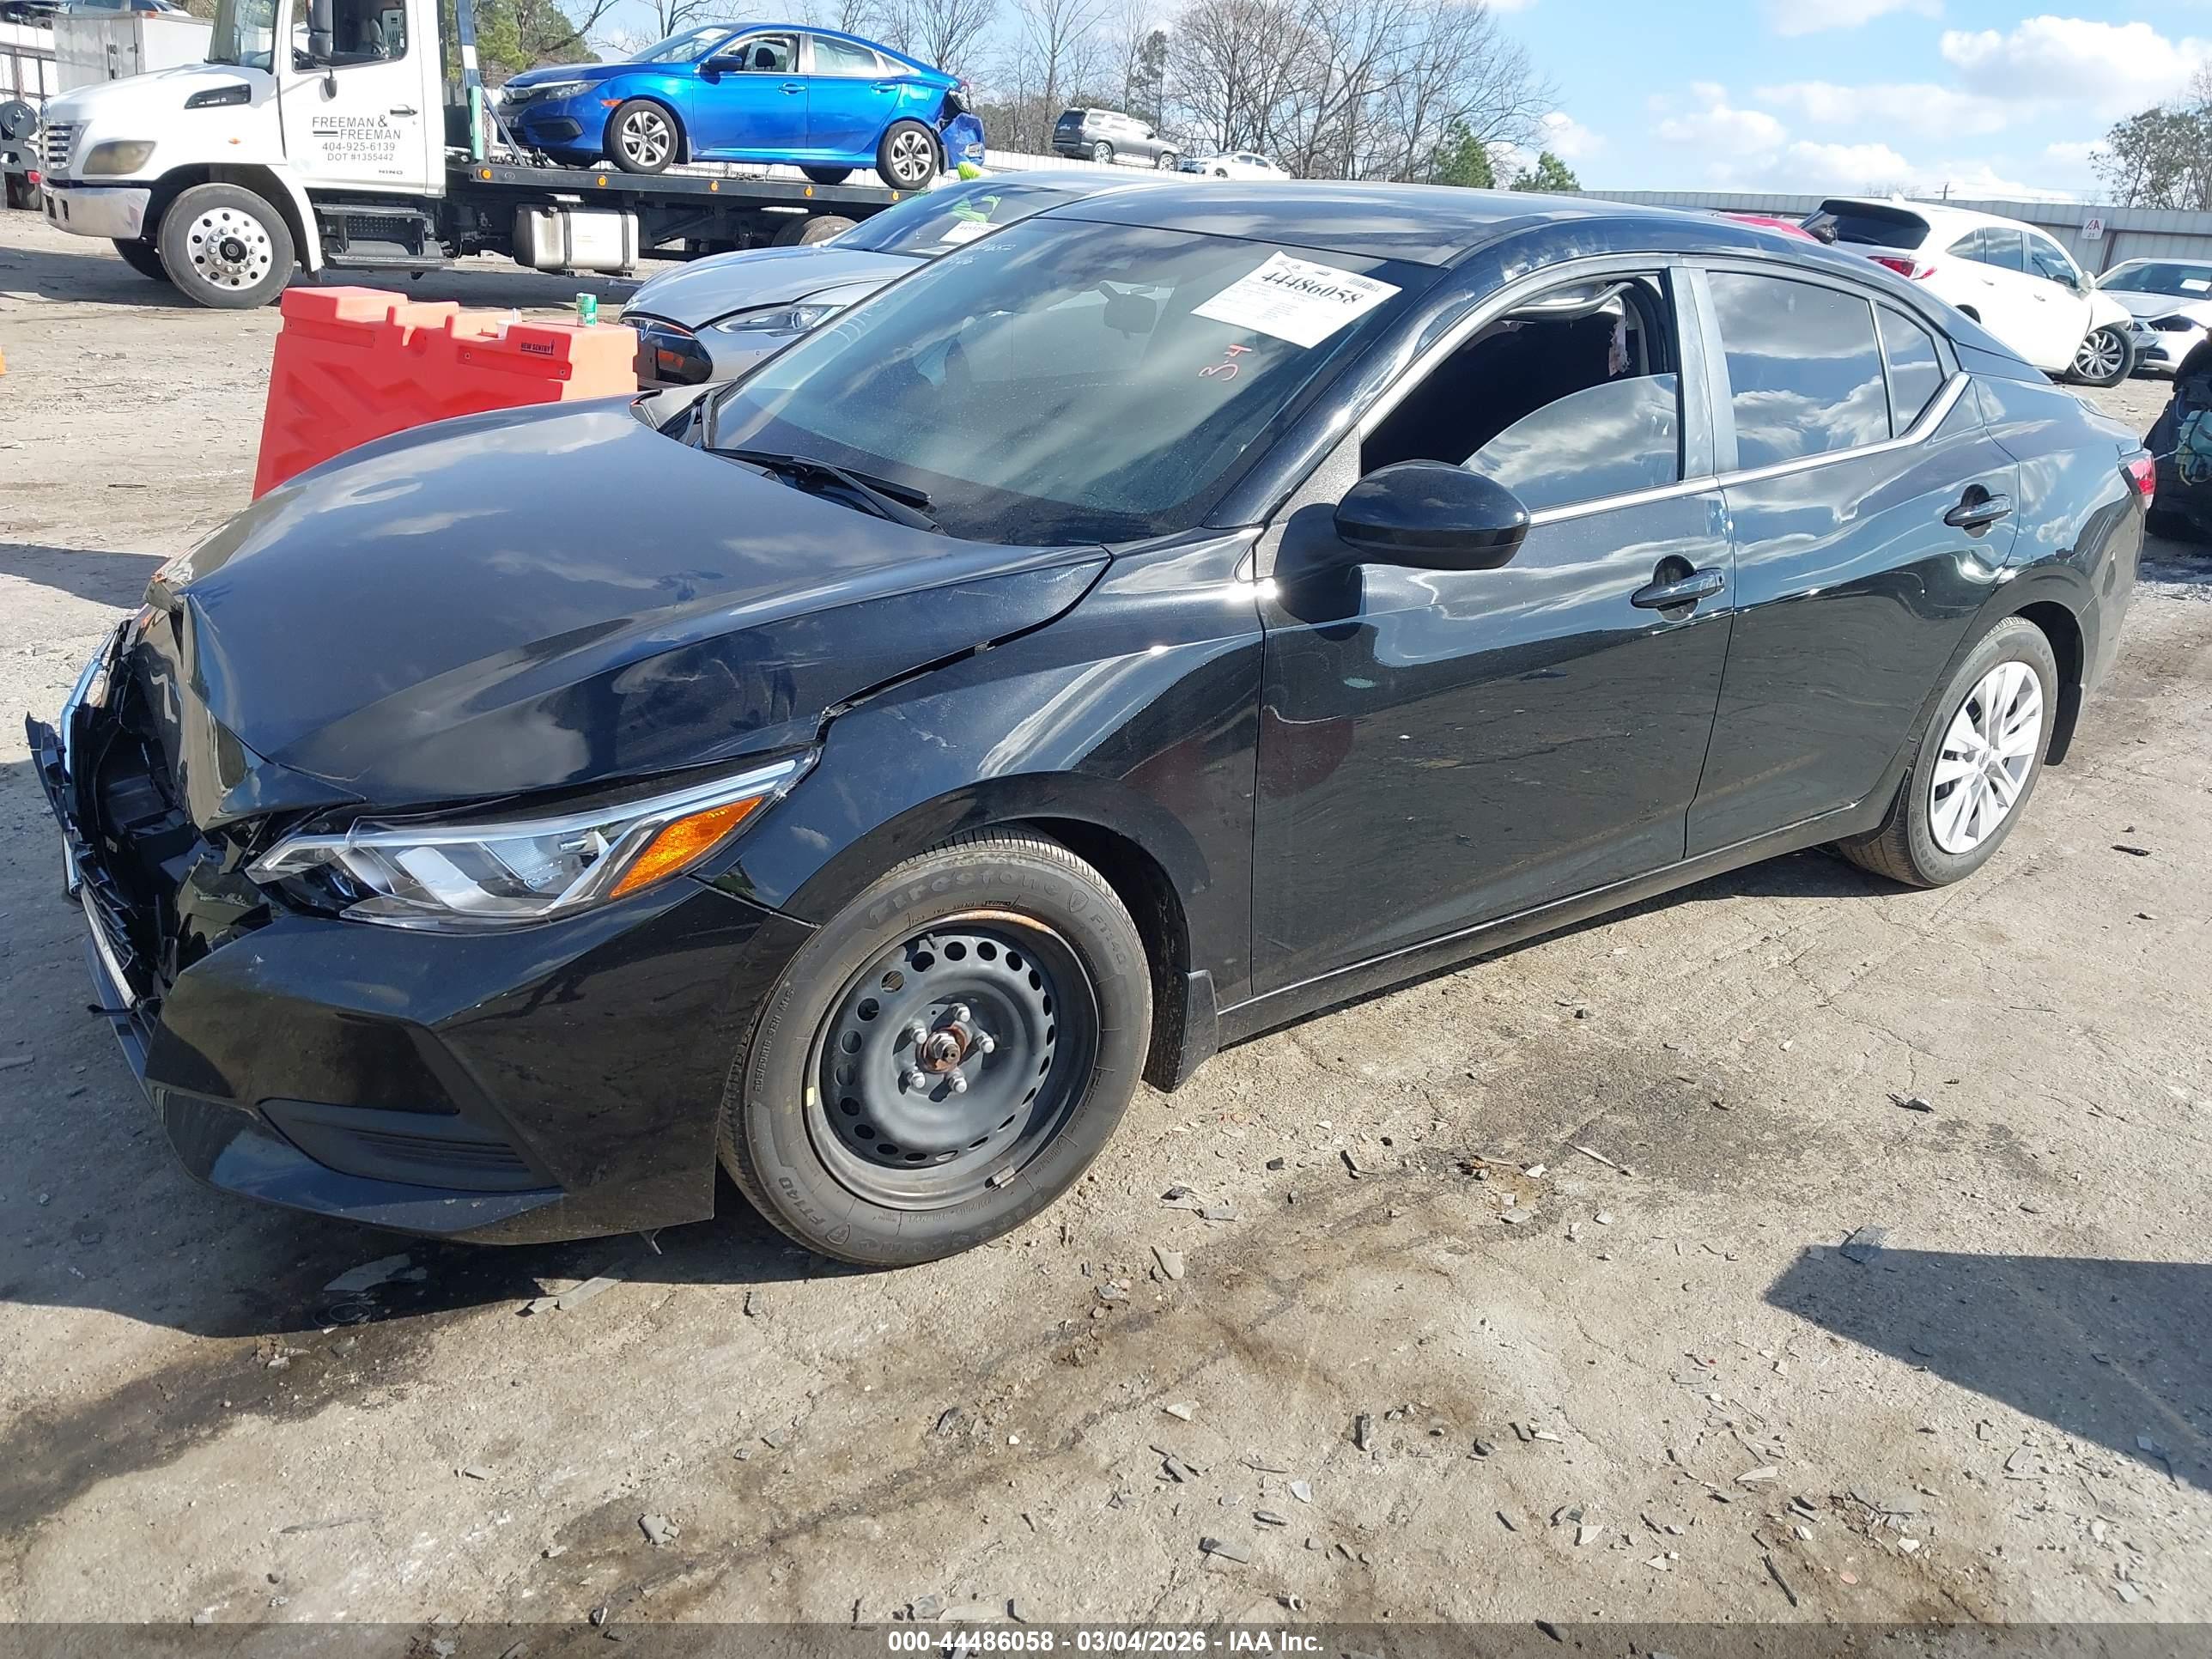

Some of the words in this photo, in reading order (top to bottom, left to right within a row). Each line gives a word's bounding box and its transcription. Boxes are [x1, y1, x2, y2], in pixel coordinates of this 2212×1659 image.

[312, 116, 374, 128] FREEMAN
[378, 114, 388, 128] &
[340, 129, 401, 140] FREEMAN
[322, 142, 395, 151] 404-925-6139
[327, 153, 348, 161] DOT
[350, 153, 394, 161] #1355442
[1261, 271, 1364, 304] 44486058
[777, 1176, 825, 1228] FT140
